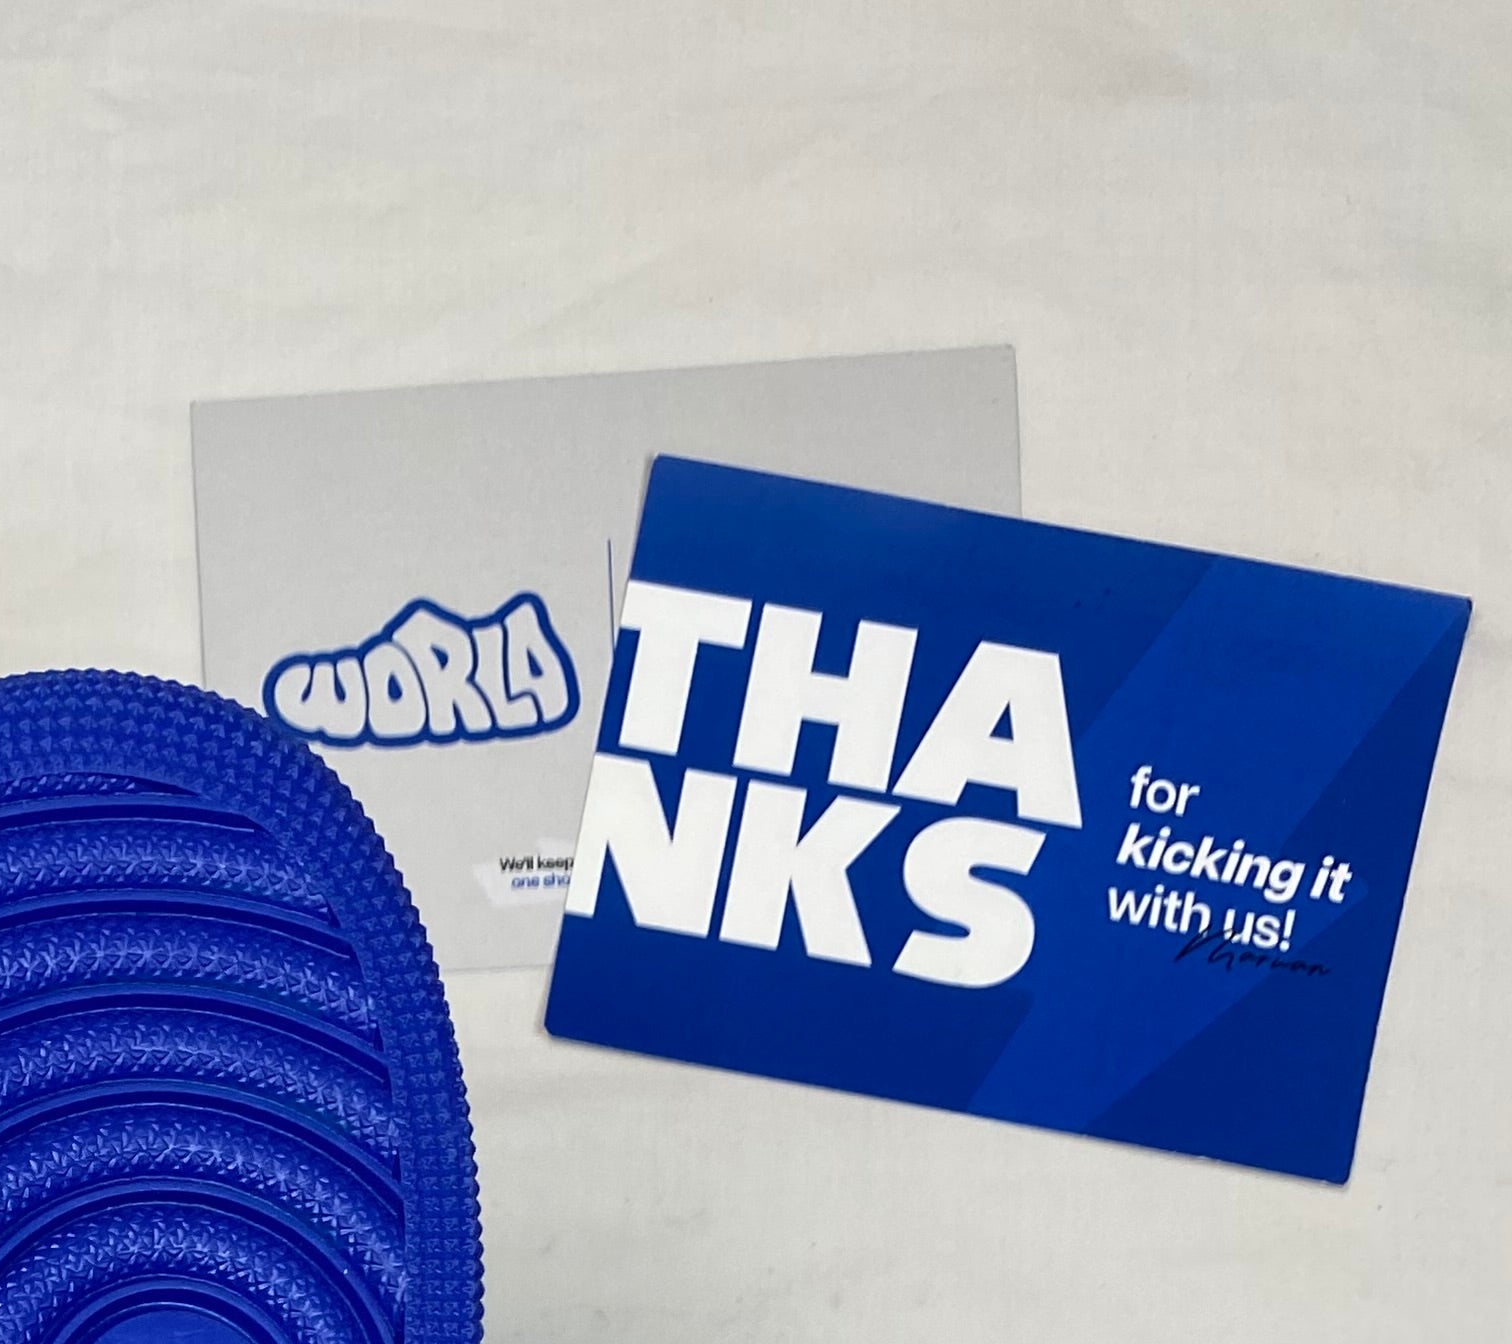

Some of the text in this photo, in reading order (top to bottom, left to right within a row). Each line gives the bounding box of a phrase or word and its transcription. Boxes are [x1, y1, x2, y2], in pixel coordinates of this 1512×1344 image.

[619, 579, 1083, 829] THA
[1129, 764, 1201, 818] for
[499, 855, 575, 872] We'll keep
[511, 872, 571, 889] one sho
[565, 752, 1047, 989] NKS
[1115, 822, 1353, 904] kicking it
[1107, 884, 1297, 952] with us!
